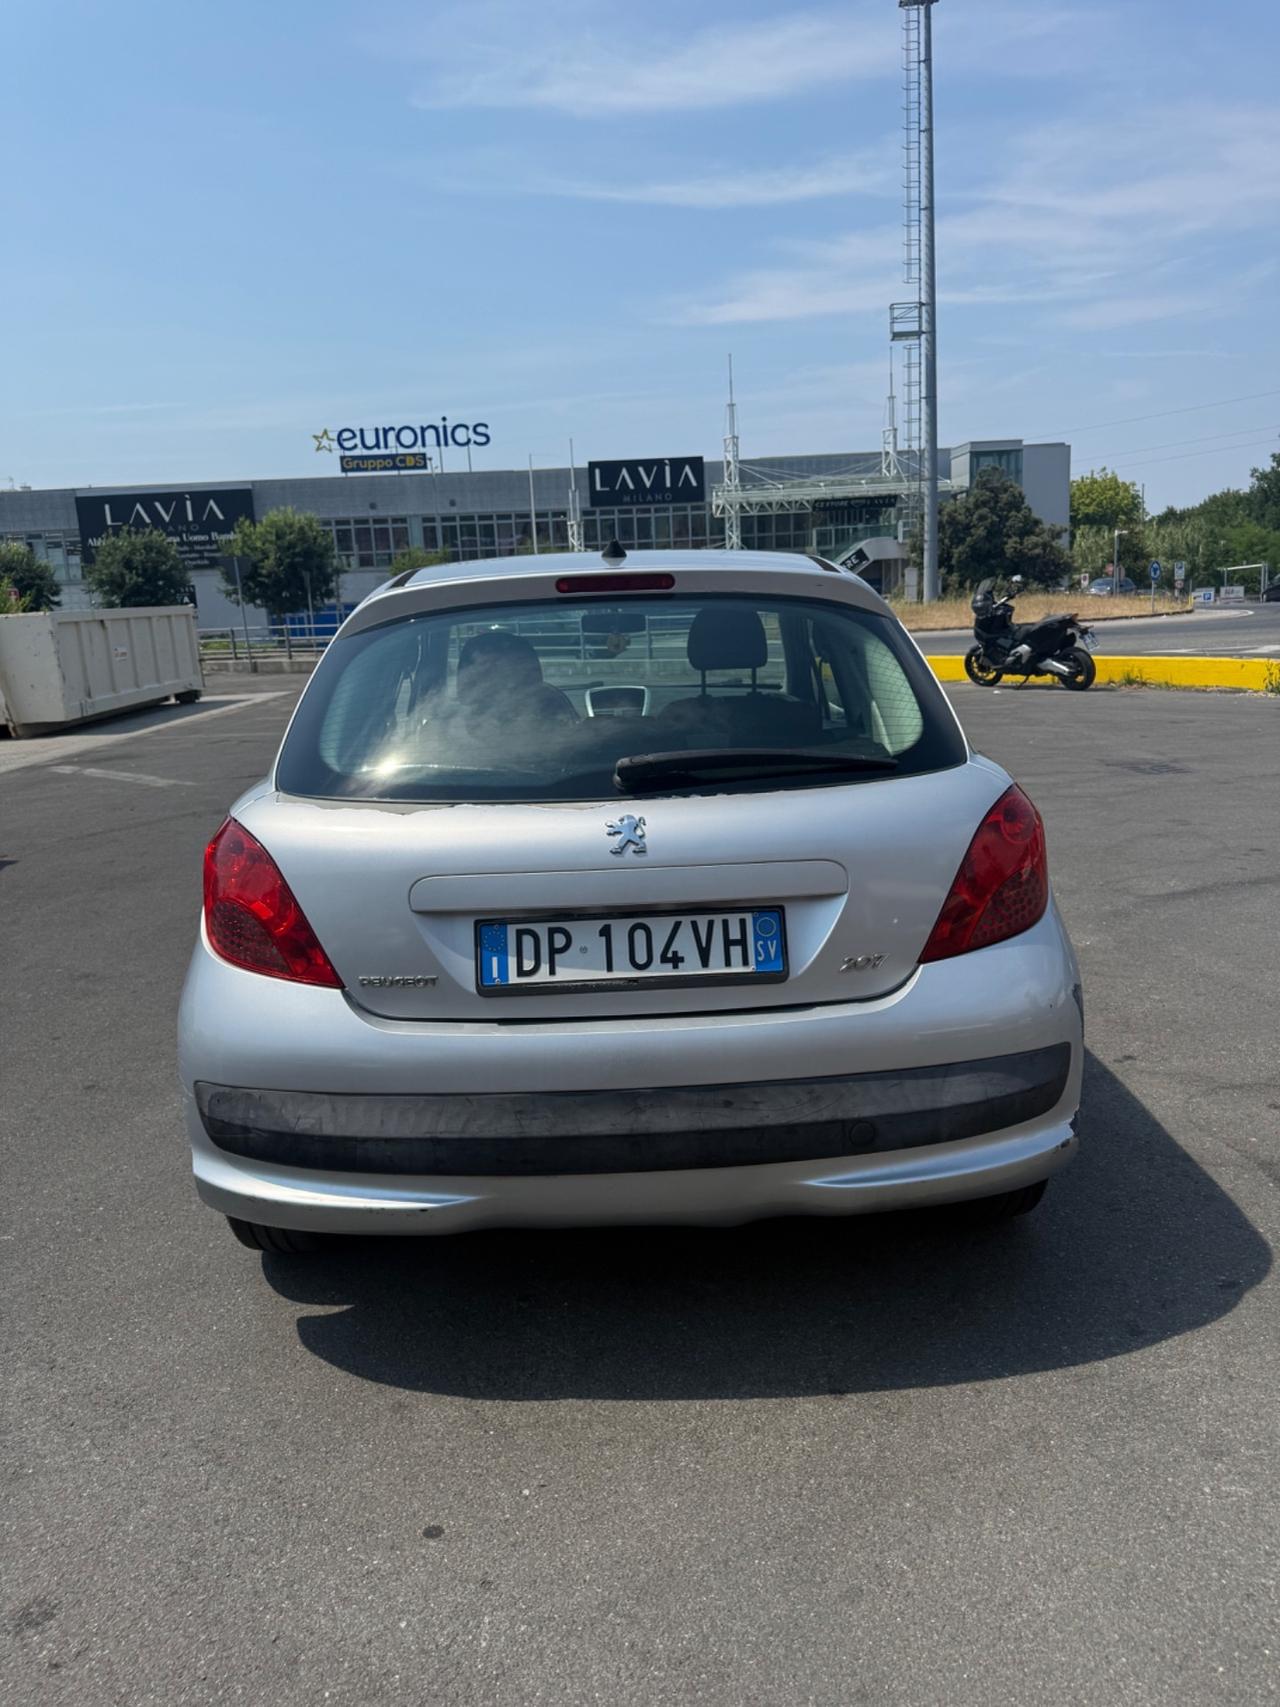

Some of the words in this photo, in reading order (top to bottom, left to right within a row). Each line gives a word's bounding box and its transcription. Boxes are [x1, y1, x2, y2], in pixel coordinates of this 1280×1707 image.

[336, 416, 491, 451] euronics
[342, 457, 394, 471] Gruppo
[594, 459, 698, 491] LAVÌA
[623, 492, 672, 502] MILANO
[104, 494, 225, 526] LAVÌA
[182, 533, 209, 541] Uomo
[514, 926, 573, 978] DP
[598, 917, 750, 973] 104VH
[756, 940, 777, 962] SV
[839, 953, 887, 971] 207
[358, 976, 439, 988] PEUGEOT
